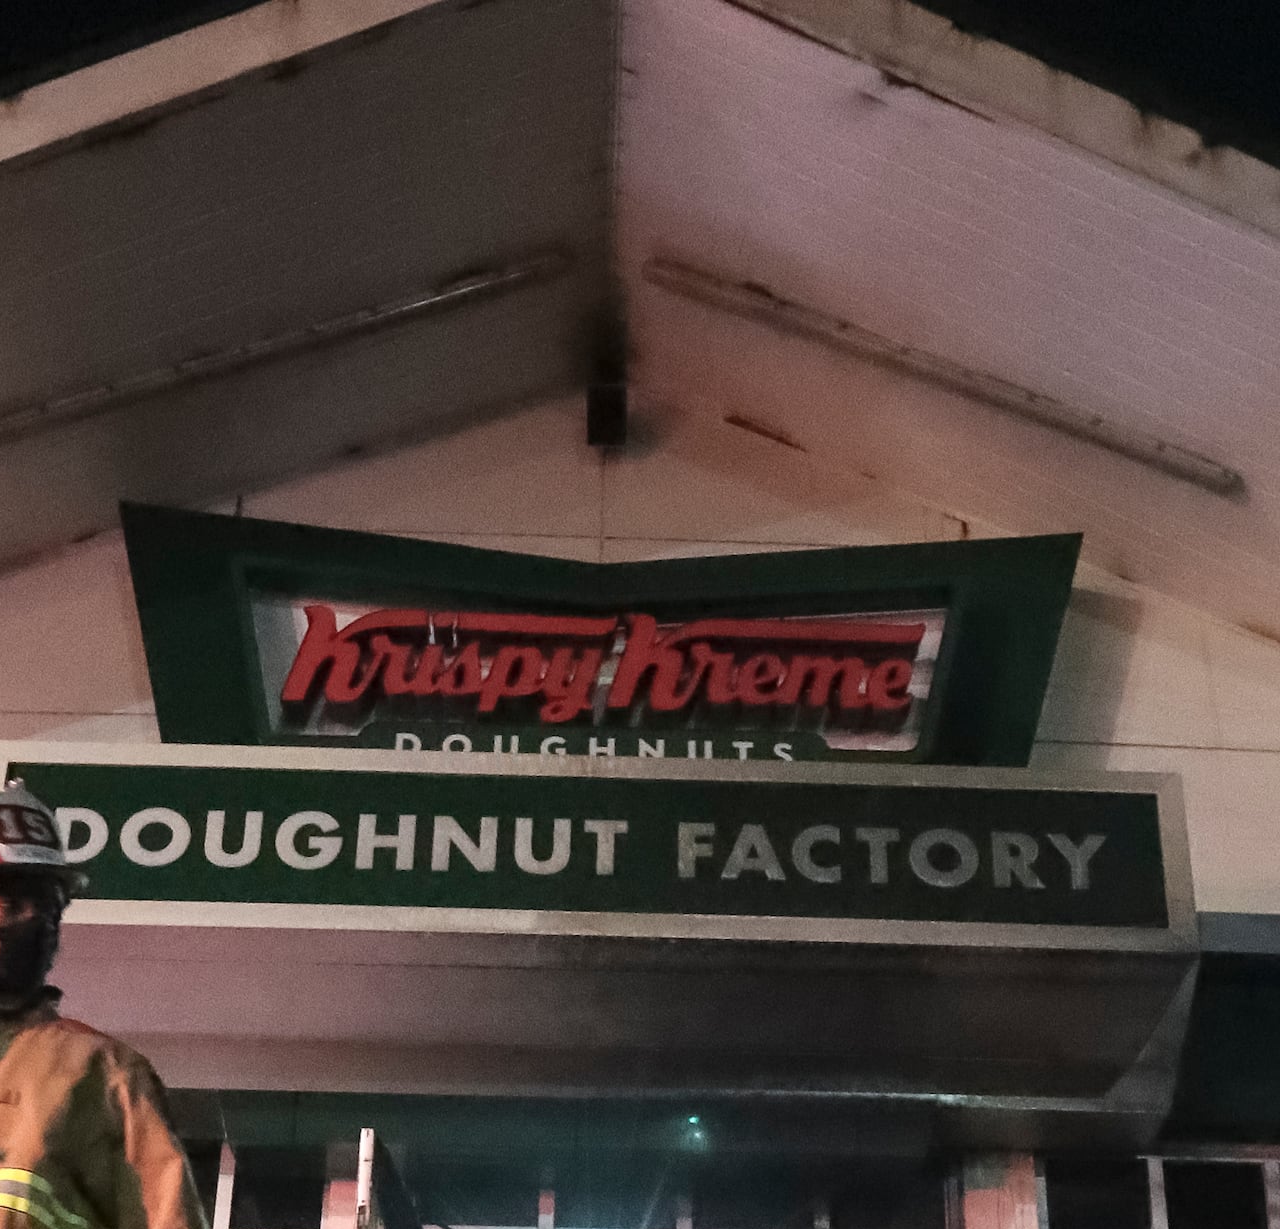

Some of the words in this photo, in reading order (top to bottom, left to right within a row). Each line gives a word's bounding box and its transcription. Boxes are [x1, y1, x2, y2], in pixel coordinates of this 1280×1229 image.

[282, 603, 618, 723] Krispy
[608, 612, 926, 710] Kreme
[54, 806, 629, 876] DOUGHNUT
[676, 821, 1109, 893] FACTORY
